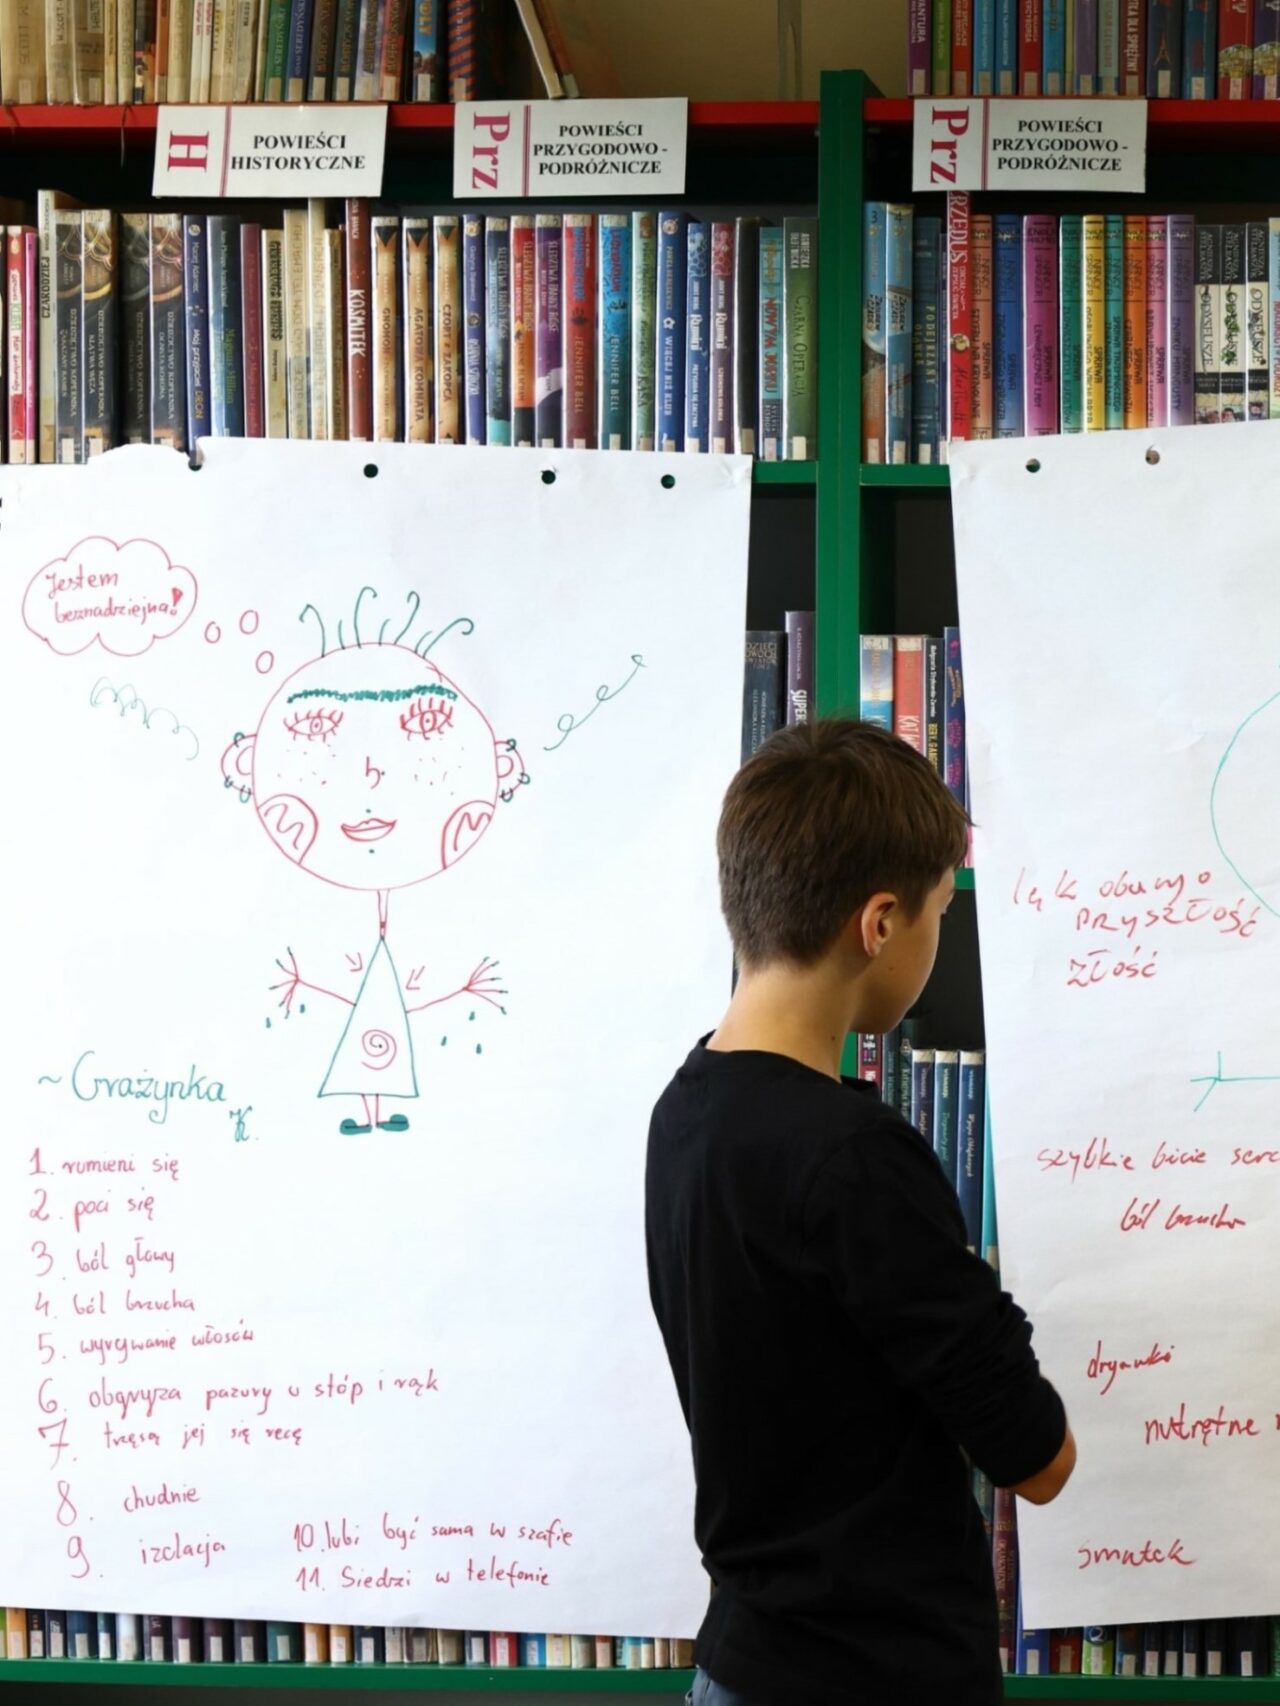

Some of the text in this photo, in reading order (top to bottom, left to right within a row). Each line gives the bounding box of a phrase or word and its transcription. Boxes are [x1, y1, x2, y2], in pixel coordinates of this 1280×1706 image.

[253, 131, 346, 150] POWIEŚCI
[559, 121, 643, 137] POWIEŚCI
[1018, 117, 1103, 133] POWIEŚCI
[167, 131, 209, 172] H
[231, 155, 366, 171] HISTORYCZNE
[472, 112, 511, 190] Prz
[533, 142, 658, 156] PRZYGODOWO
[930, 106, 969, 184] Prz
[992, 138, 1118, 152] PRZYGODOWO
[997, 154, 1122, 171] PODRÓŻNICZE
[538, 159, 662, 175] PODRÓŻNICZE
[41, 257, 51, 318] CZARODZIEJ
[349, 289, 366, 357] KOSMITEK
[414, 308, 424, 421] AGATOWA KOMNATA
[663, 336, 673, 372] WIĘCEJ
[663, 393, 673, 416] KLUB
[46, 563, 118, 599] Jestem
[1198, 870, 1212, 885] o
[1066, 945, 1159, 988] złość
[71, 1050, 227, 1124] Grażynka
[62, 1151, 136, 1175] rumieni
[152, 1152, 179, 1181] się
[73, 1189, 110, 1233] poci
[127, 1187, 155, 1221] się
[76, 1242, 109, 1273] ból
[125, 1236, 176, 1279] głowy
[73, 1291, 106, 1315] ból
[126, 1289, 196, 1312] brzucha
[80, 1329, 177, 1366] wyrywanie
[191, 1319, 254, 1346] włosów
[205, 1387, 273, 1416] pazury
[288, 1386, 300, 1398] u
[315, 1373, 363, 1405] stóp
[394, 1368, 439, 1397] rąk
[182, 1424, 205, 1450] jej
[231, 1419, 251, 1444] się
[123, 1483, 201, 1513] chudnie
[327, 1517, 360, 1550] lubi
[382, 1512, 420, 1550] być
[431, 1524, 474, 1537] sama
[490, 1523, 506, 1538] w
[517, 1518, 574, 1549] szafie
[140, 1532, 226, 1568] izolacja
[341, 1565, 411, 1589] Siedzi
[435, 1571, 451, 1584] w
[467, 1555, 550, 1588] telefonie
